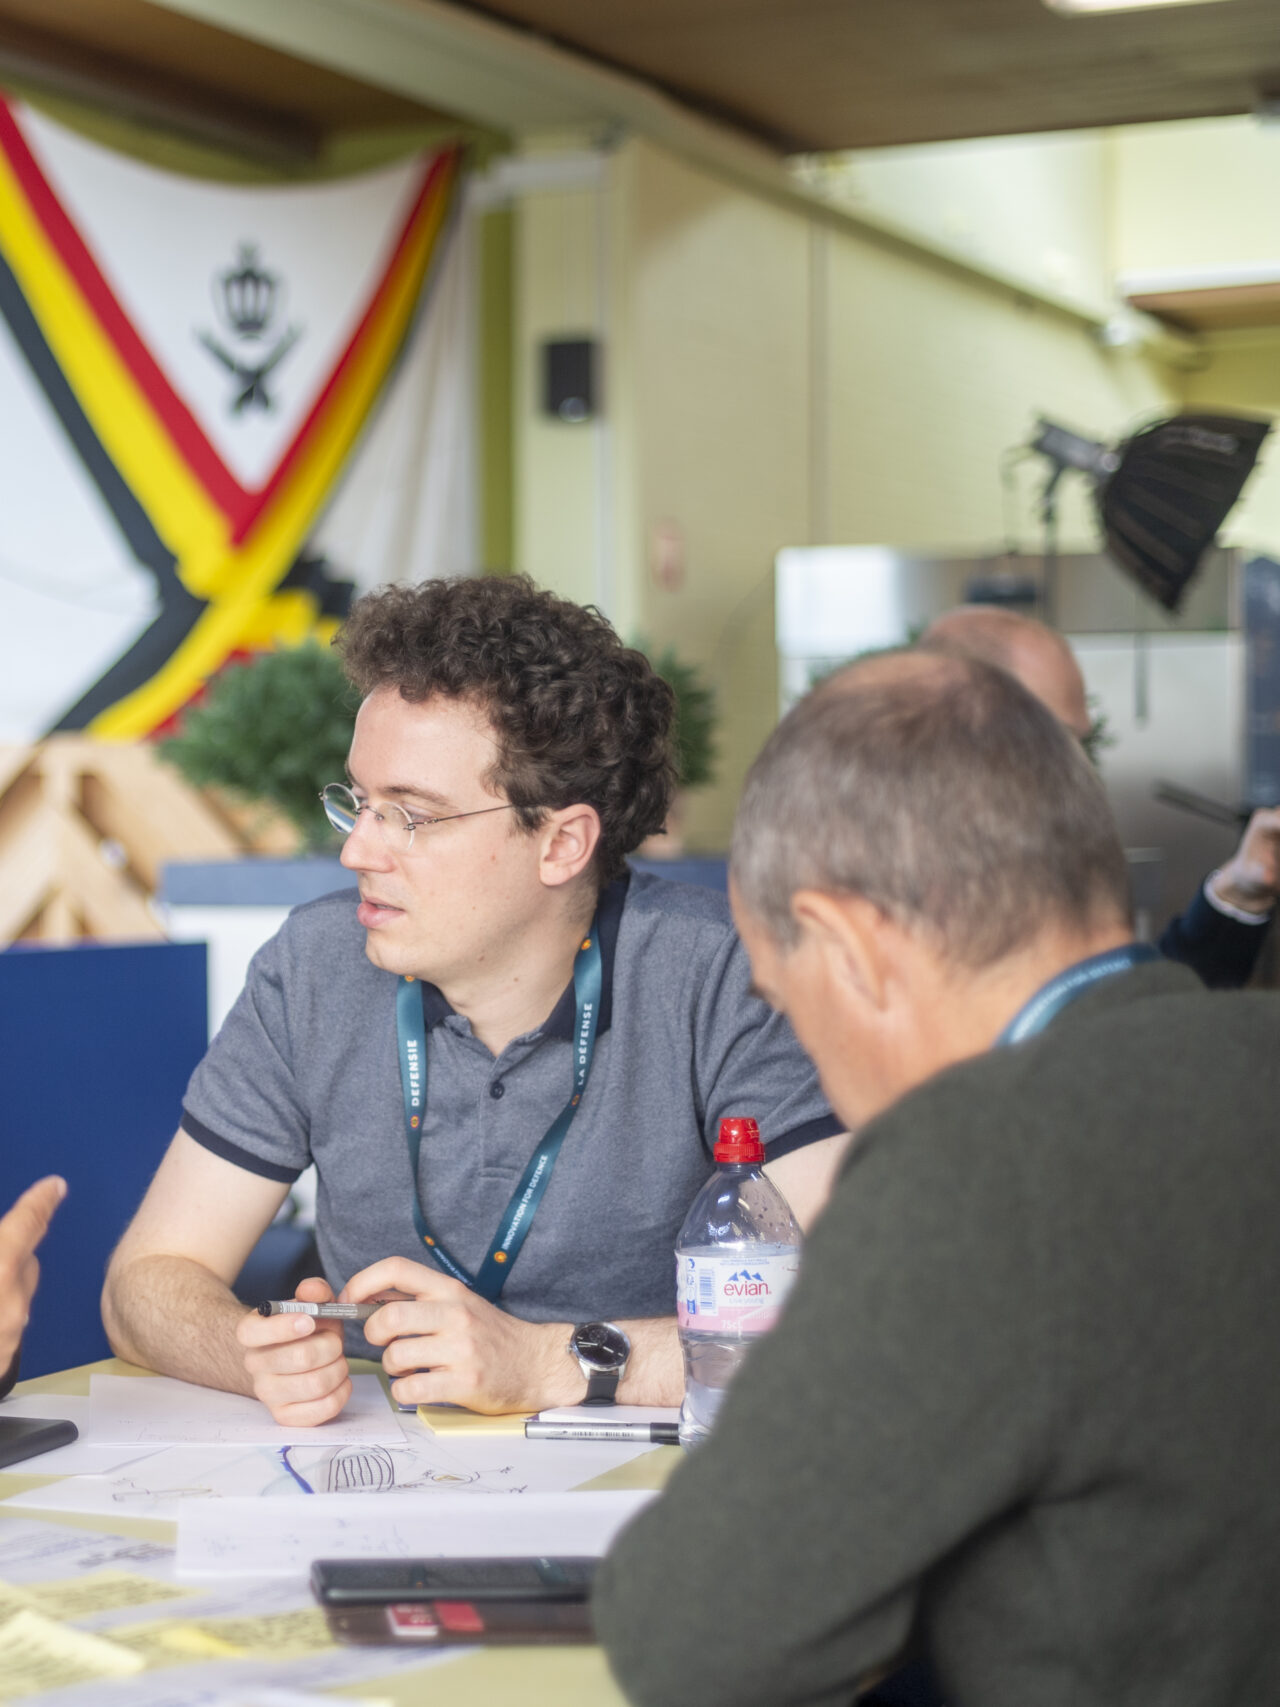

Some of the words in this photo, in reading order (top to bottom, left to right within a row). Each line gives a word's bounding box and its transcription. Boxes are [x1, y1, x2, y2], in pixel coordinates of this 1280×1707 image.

[579, 1003, 593, 1065] DÉFENSE
[407, 1039, 420, 1107] DEFENSIE
[578, 1069, 586, 1086] LA
[501, 1201, 528, 1251] INNOVATION
[522, 1186, 534, 1204] FOR
[529, 1154, 548, 1190] DEFENCE
[724, 1280, 769, 1296] evian
